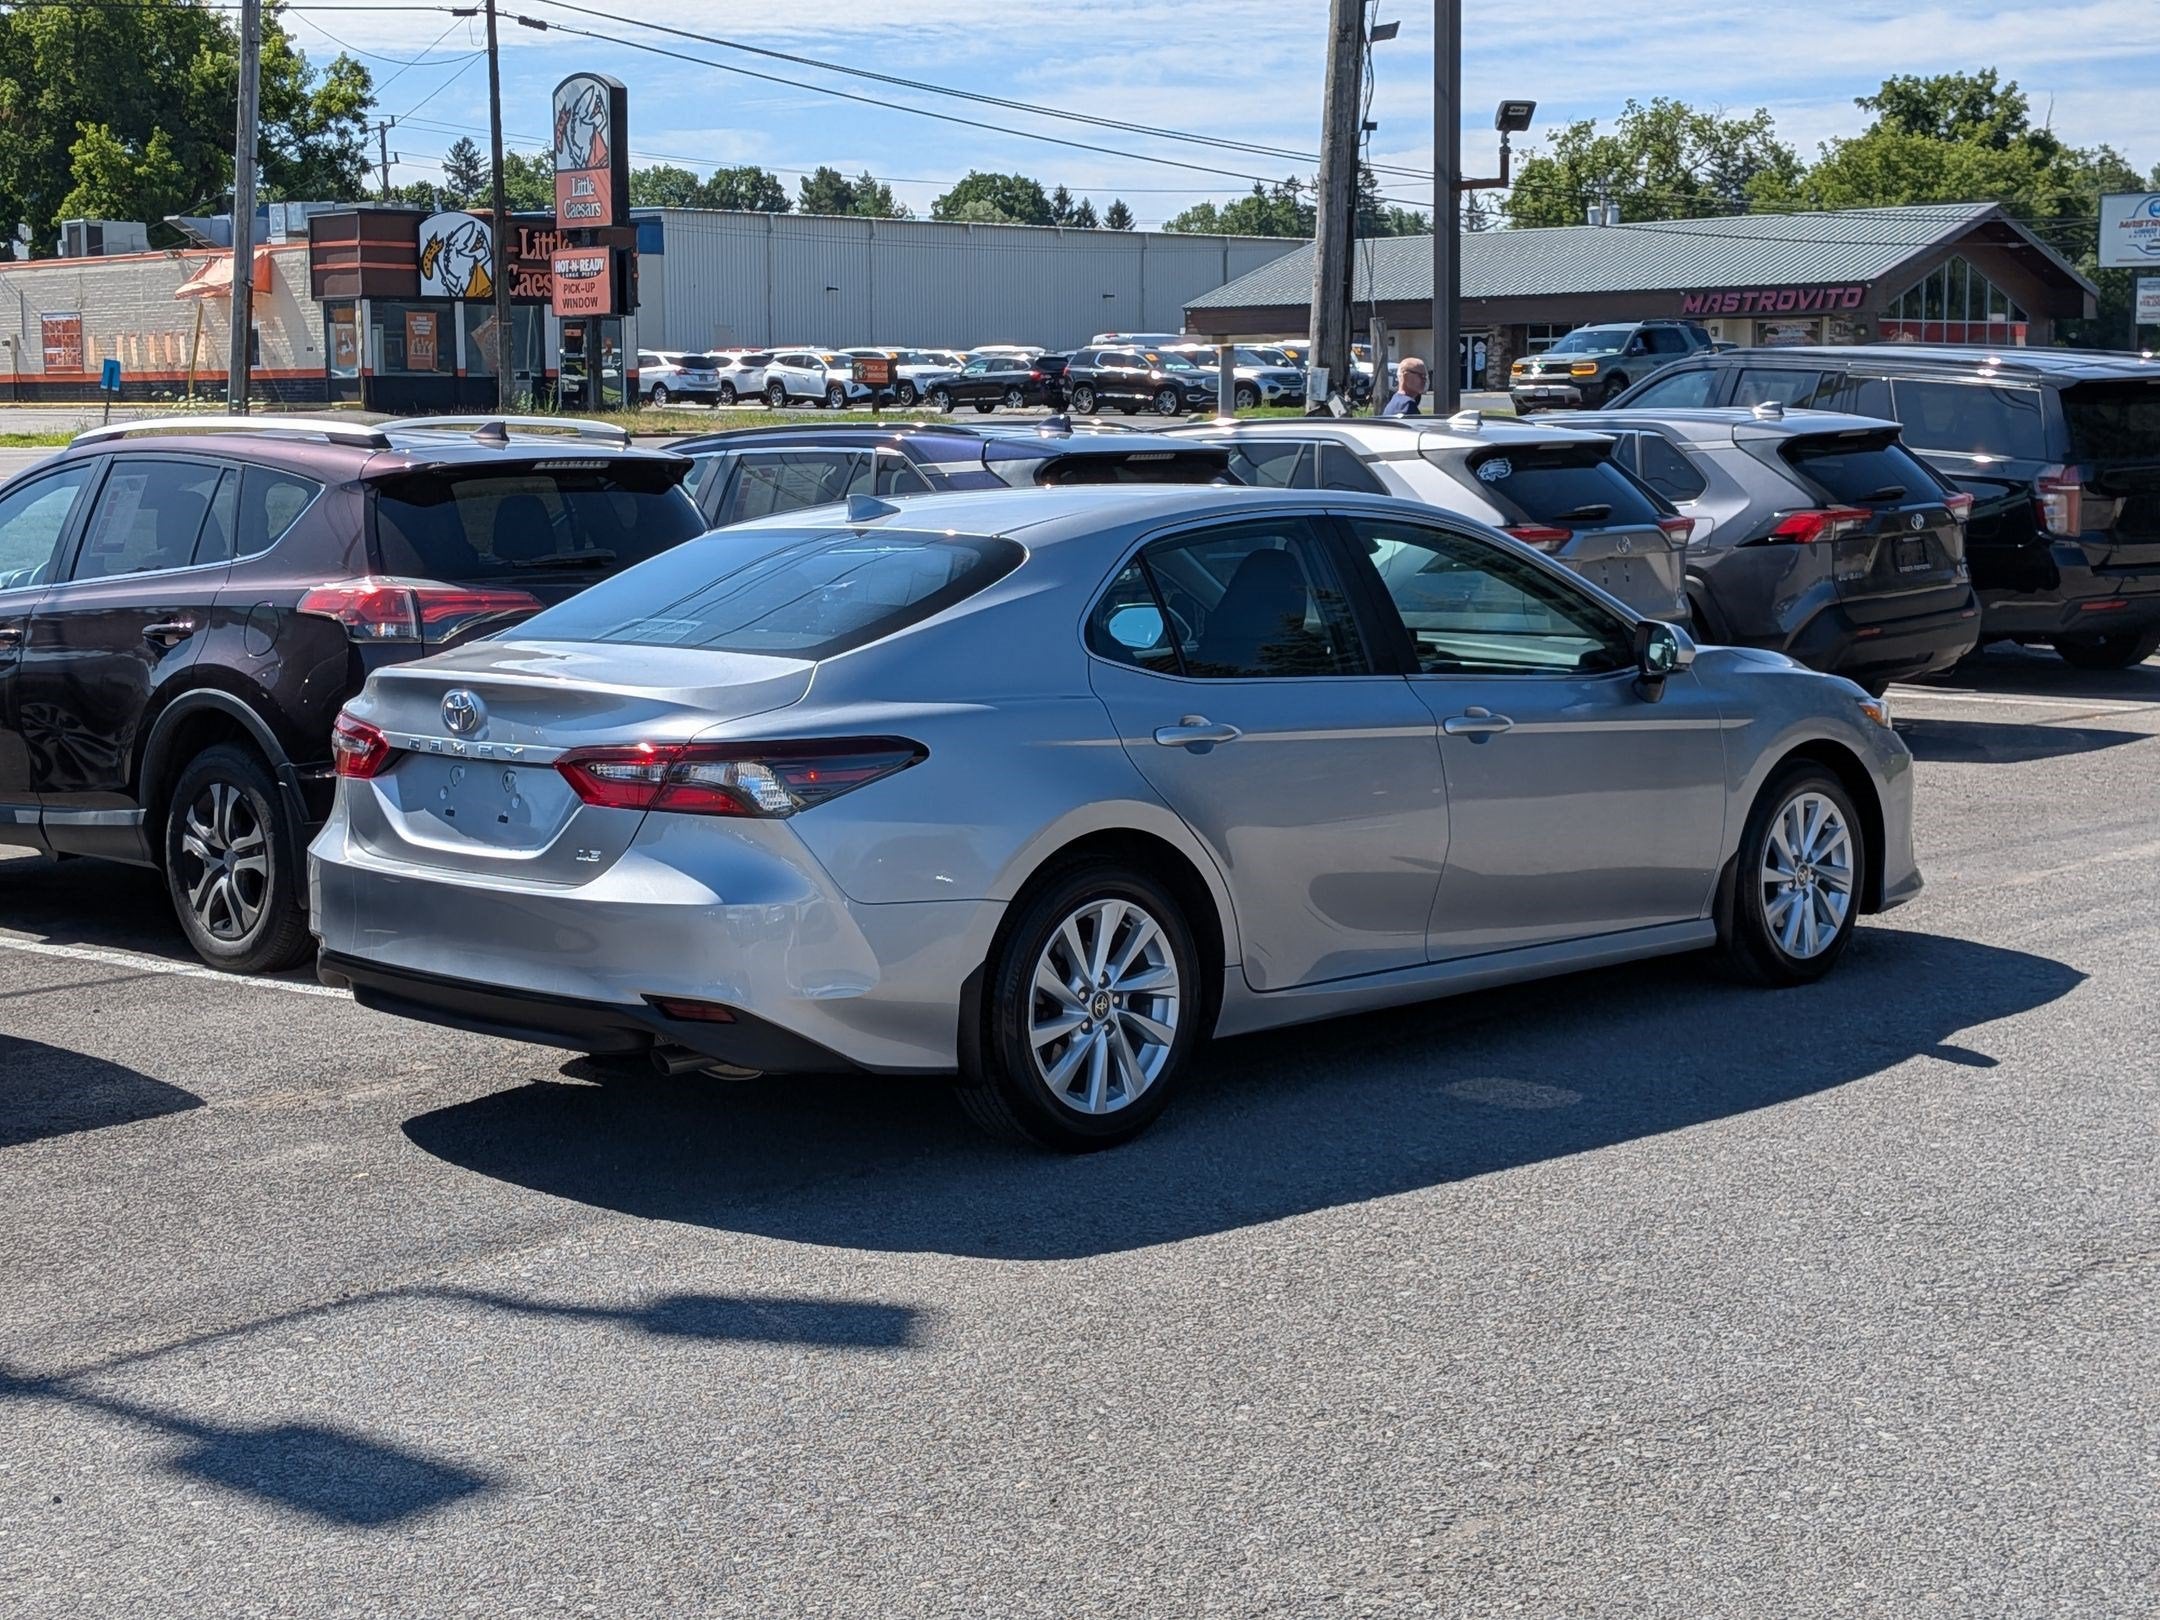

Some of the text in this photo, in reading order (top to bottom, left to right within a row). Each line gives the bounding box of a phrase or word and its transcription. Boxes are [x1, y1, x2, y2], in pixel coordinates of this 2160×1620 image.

[571, 176, 595, 197] Little
[563, 198, 602, 219] Caesars
[554, 258, 605, 273] HOT-N-READY
[507, 263, 553, 297] Caes
[563, 281, 596, 294] PICK-UP
[562, 296, 599, 309] WINDOW
[1682, 286, 1864, 314] MASTROVITO
